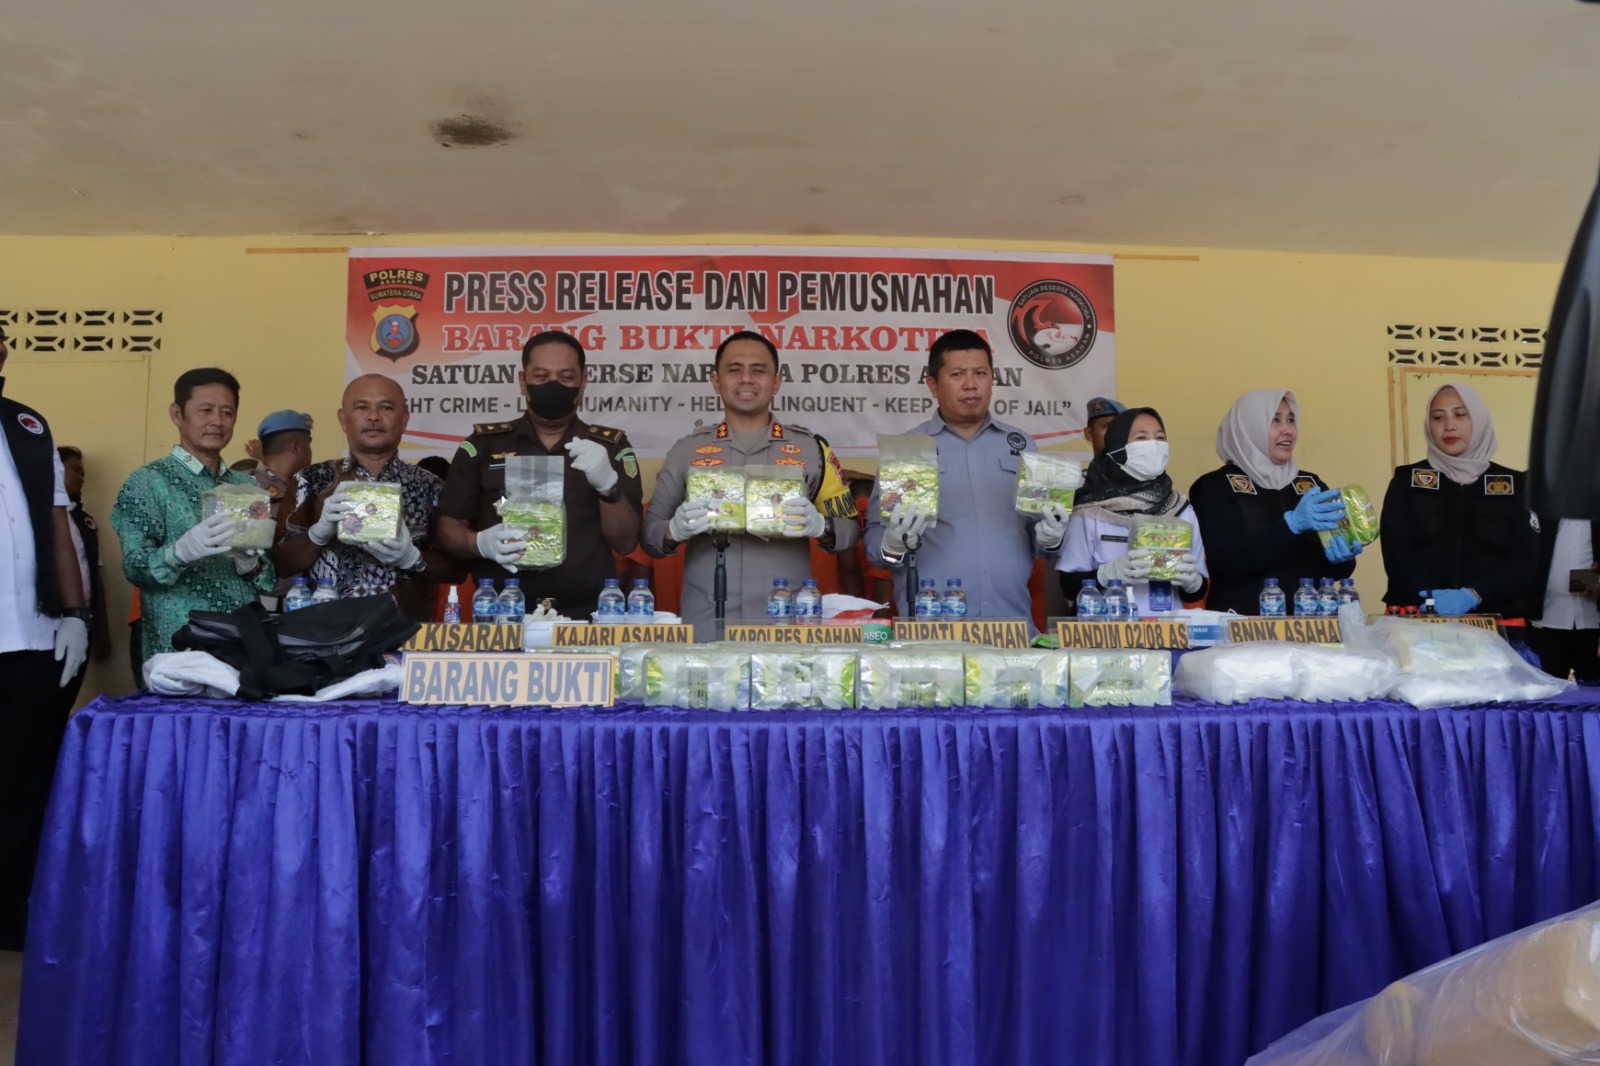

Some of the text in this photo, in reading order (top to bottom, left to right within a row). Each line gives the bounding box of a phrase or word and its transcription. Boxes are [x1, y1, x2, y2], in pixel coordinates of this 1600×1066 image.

[369, 269, 424, 282] POLRES
[370, 289, 422, 300] SUMATERA UTARA
[446, 271, 994, 315] PRESS RELEASE DAN PEMUSNAHAN
[1018, 284, 1091, 320] SATUAN RESERSE NARKOBA
[1028, 333, 1090, 364] POLRES ASAHAN
[411, 364, 517, 385] SATUAN
[800, 363, 911, 385] POLRES
[439, 397, 499, 413] CRIME
[885, 397, 933, 413] KEEP
[993, 399, 1019, 415] OF
[423, 623, 521, 651] KISARAN
[555, 626, 688, 646] KAJARI ASAHAN
[806, 627, 862, 644] ASAHAN
[961, 623, 1028, 648] ASAHAN
[1061, 623, 1188, 649] DANDIM 02/08 AS
[1229, 621, 1344, 643] BNNK ASAHA
[408, 660, 609, 703] BARANG BUKTI
